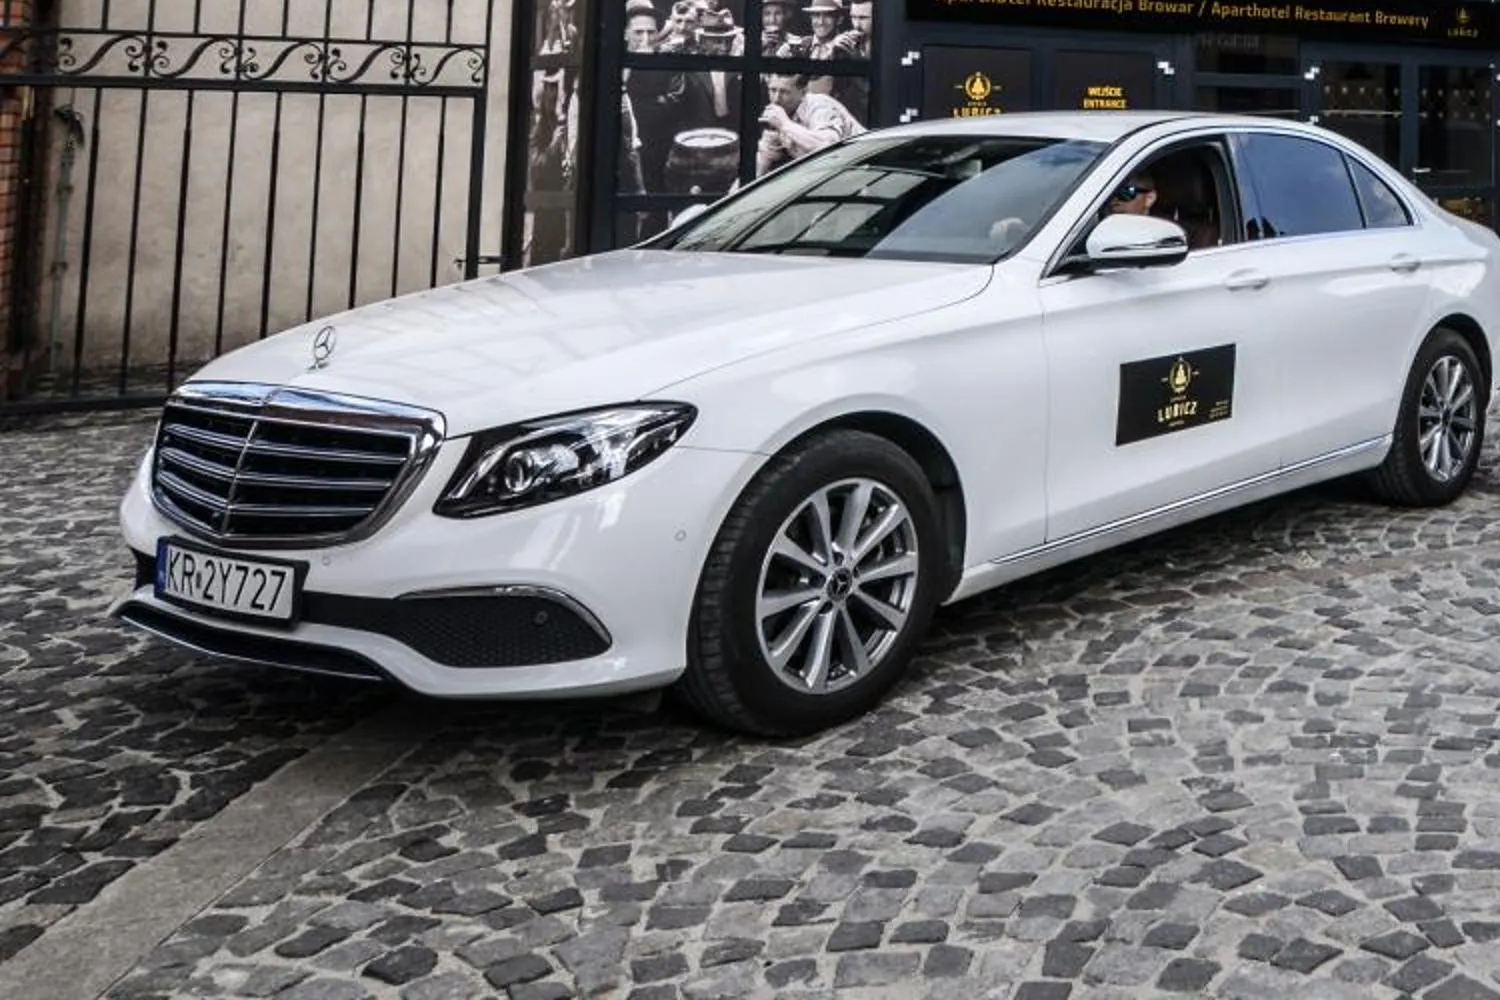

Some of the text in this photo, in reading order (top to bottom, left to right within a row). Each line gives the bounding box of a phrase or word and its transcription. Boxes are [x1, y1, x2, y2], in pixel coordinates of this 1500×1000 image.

[1211, 1, 1291, 19] Aparthotel
[1295, 6, 1371, 25] Restaurant
[1375, 11, 1429, 30] Brewery
[1083, 98, 1127, 109] ENTRANCE
[1157, 401, 1198, 423] LUBICZ
[167, 550, 287, 612] KR 2Y727
